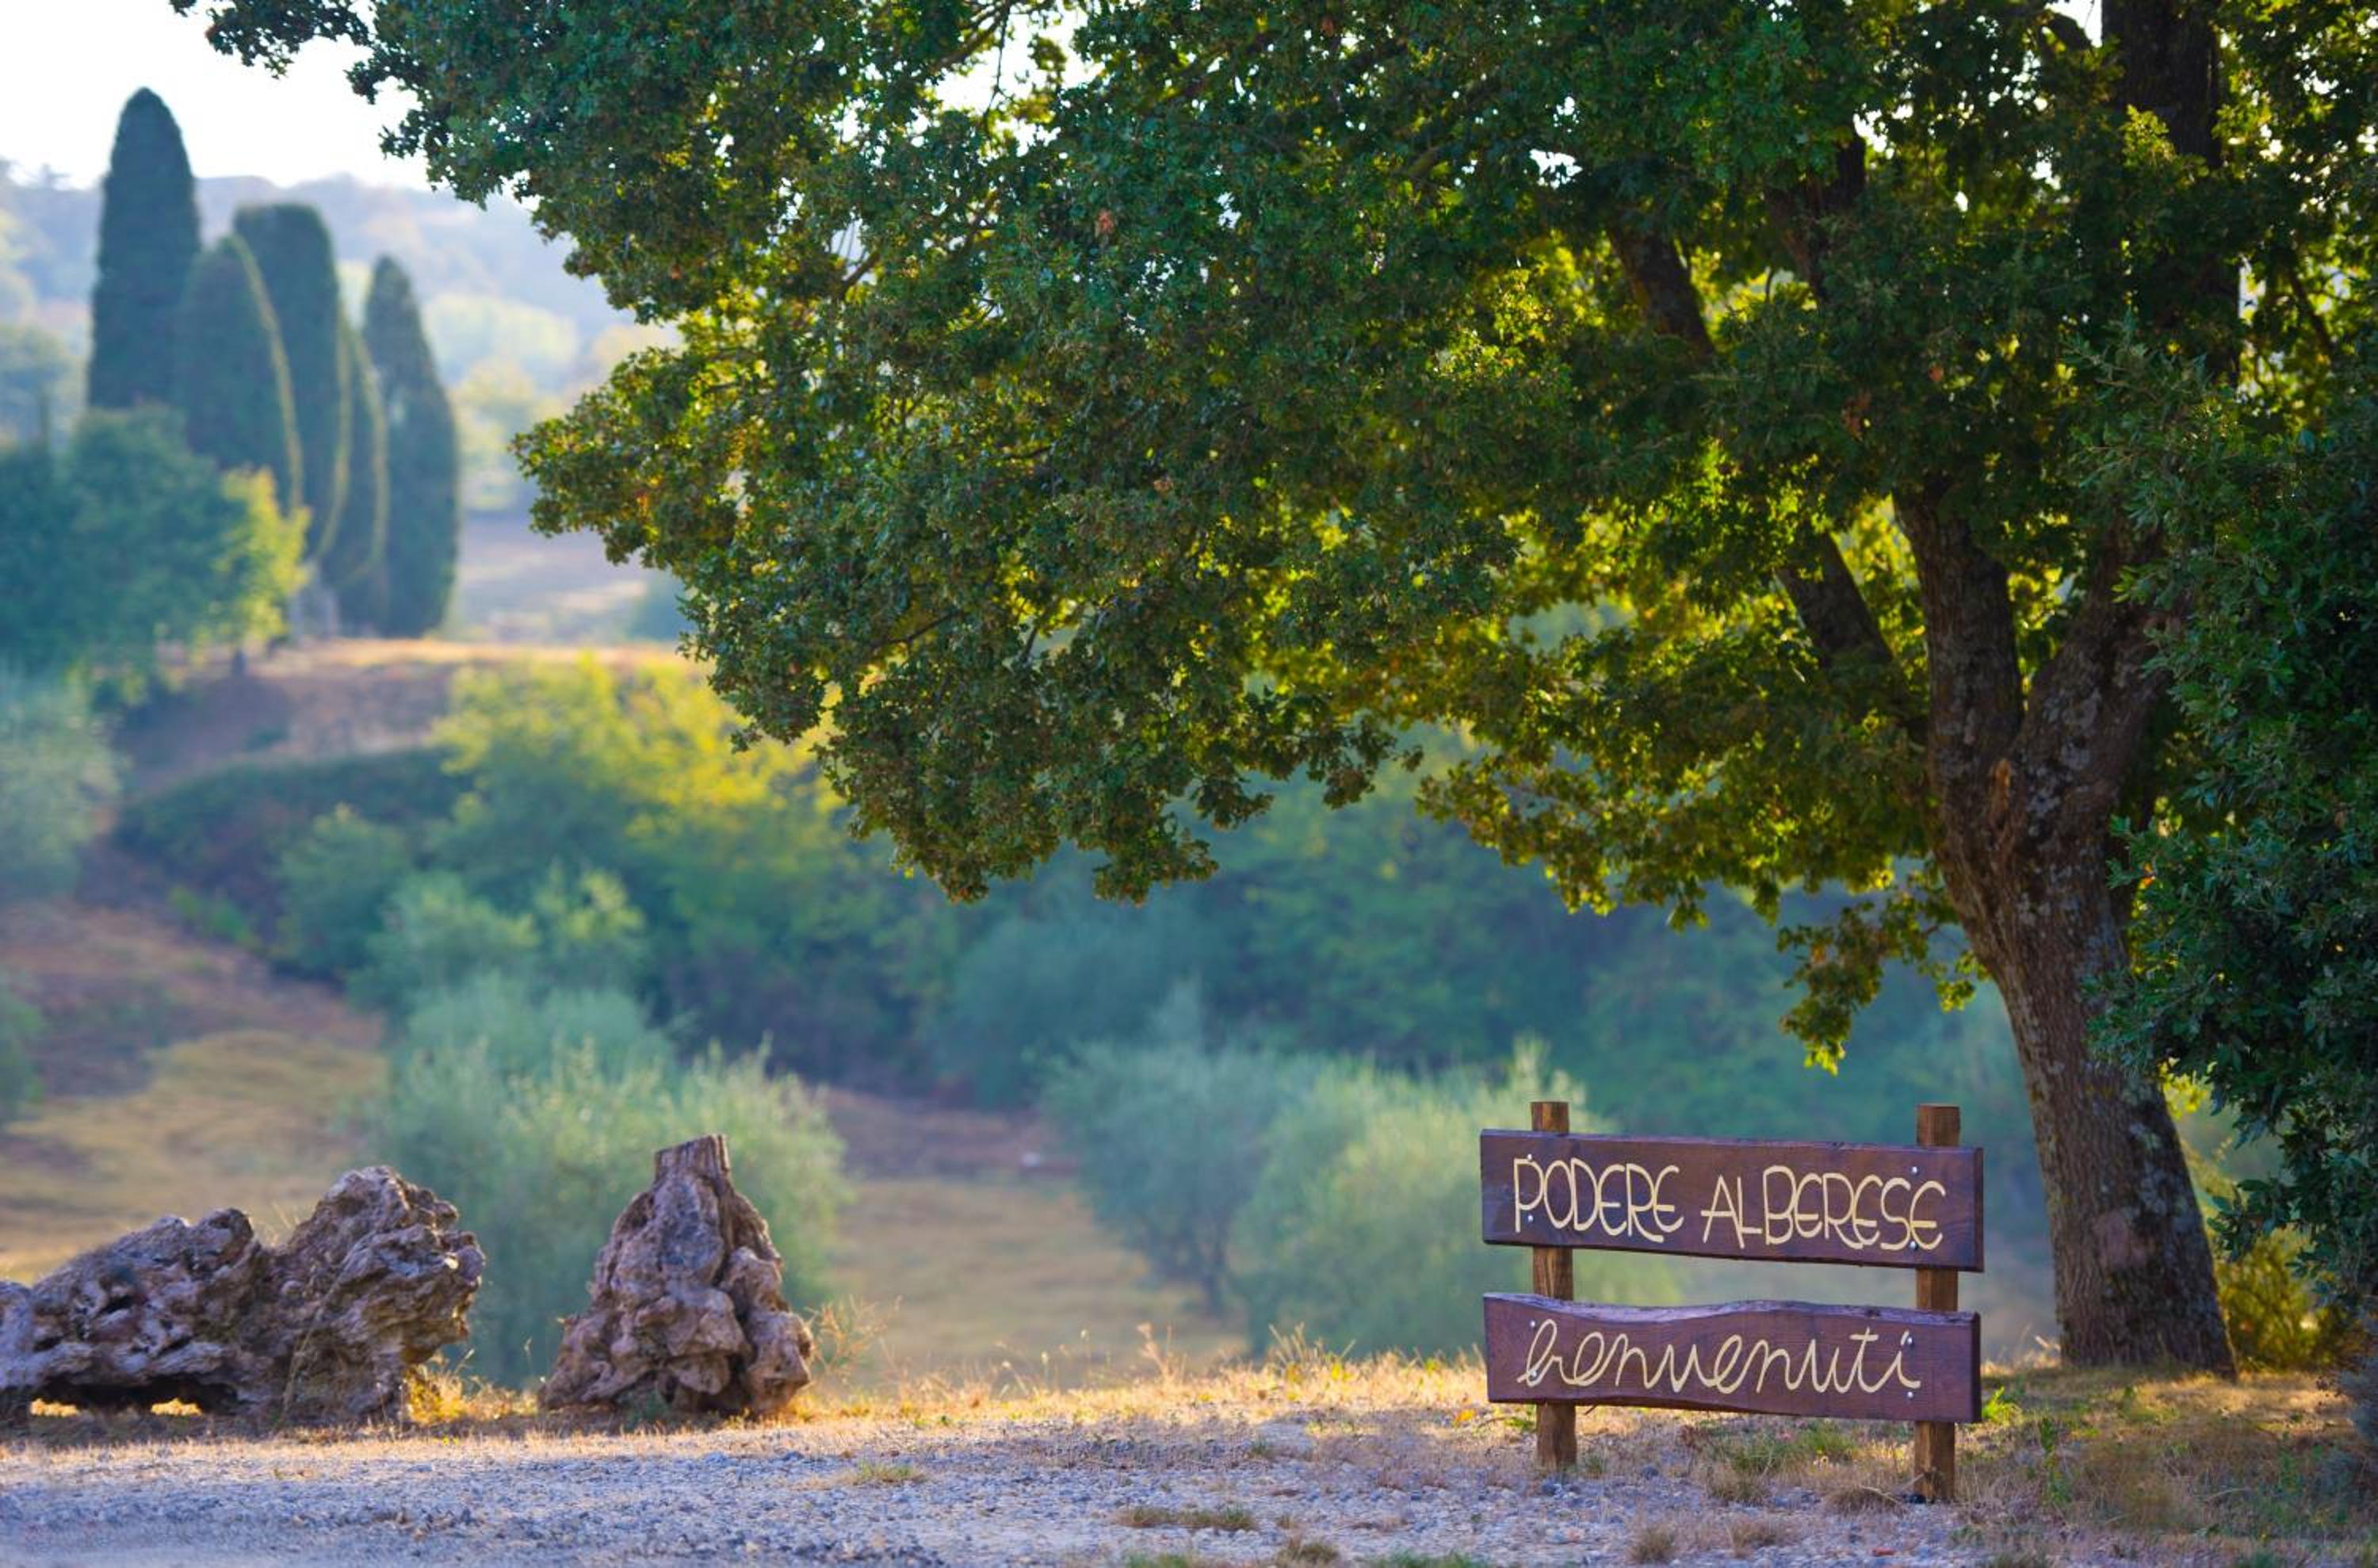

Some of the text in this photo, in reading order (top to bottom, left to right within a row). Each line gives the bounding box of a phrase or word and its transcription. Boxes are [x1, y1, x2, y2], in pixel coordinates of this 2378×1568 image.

[1513, 1157, 1947, 1250] PODERE ALBERESE
[1517, 1318, 1921, 1394] benvenuti
